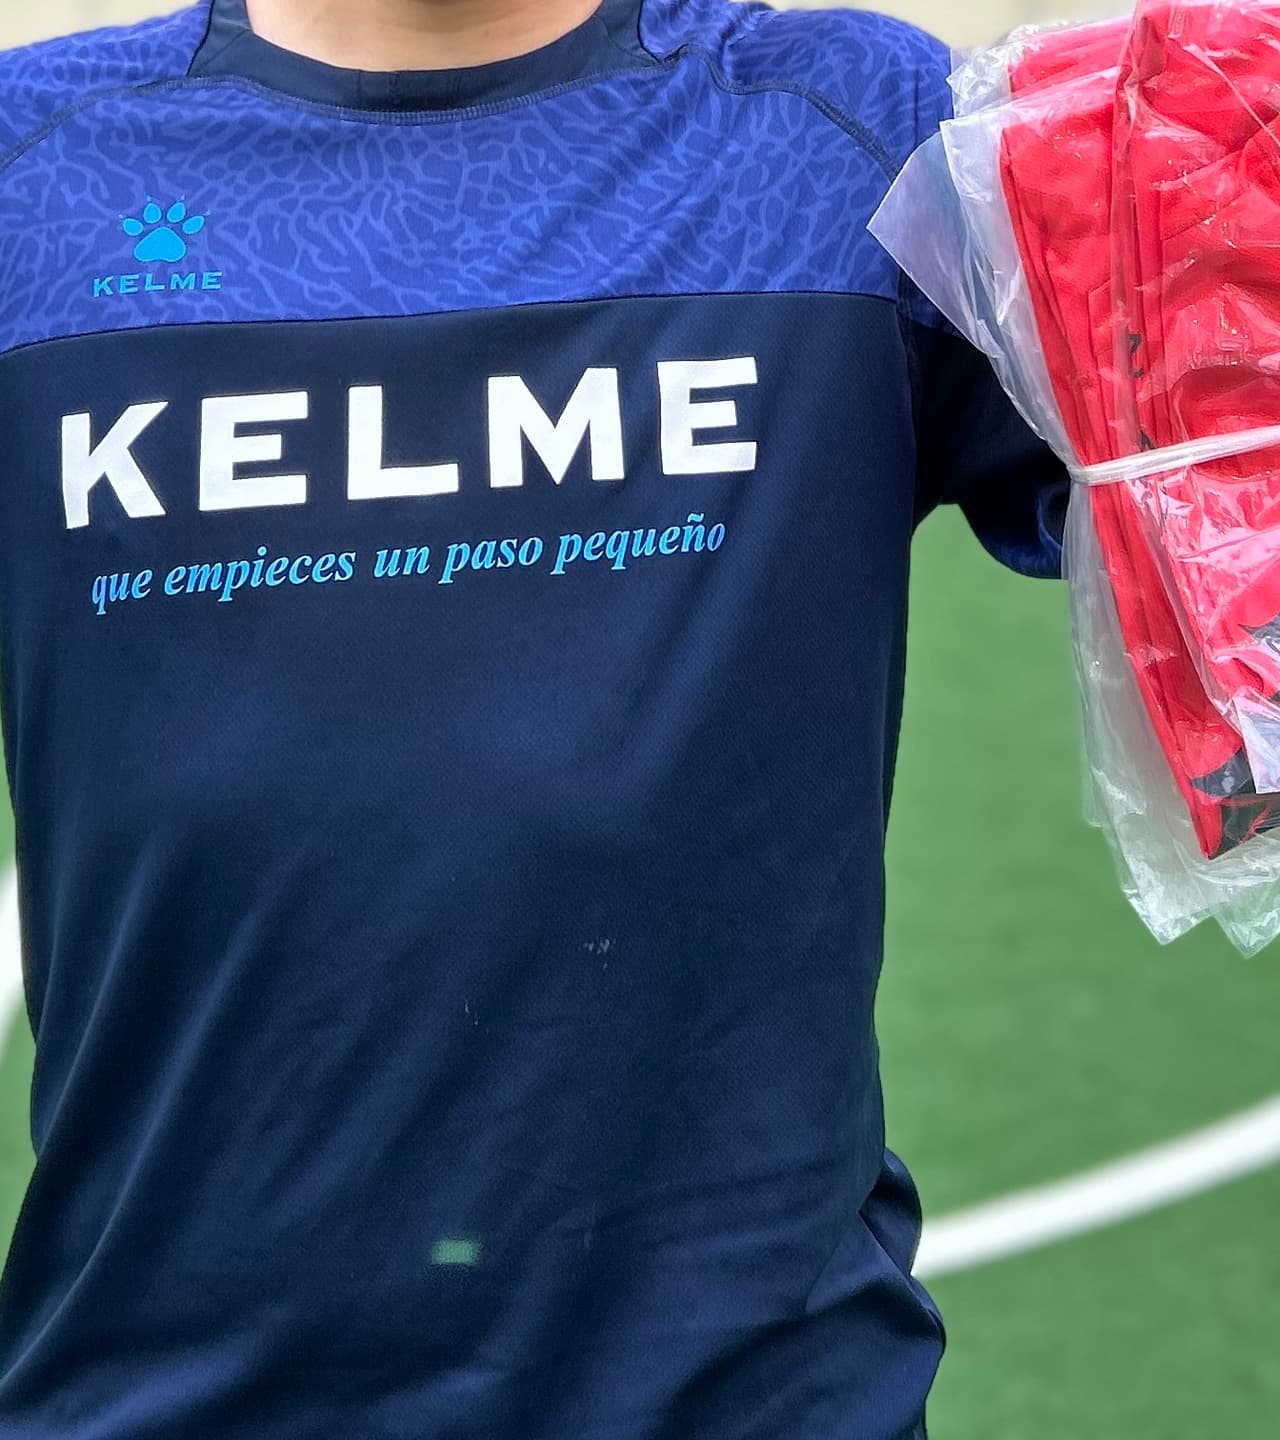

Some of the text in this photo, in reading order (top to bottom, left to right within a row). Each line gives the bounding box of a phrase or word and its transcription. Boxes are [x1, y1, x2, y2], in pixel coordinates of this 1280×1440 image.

[93, 271, 222, 297] KELME
[61, 356, 758, 530] KELME
[91, 512, 727, 614] que empieces un paso pequeño
